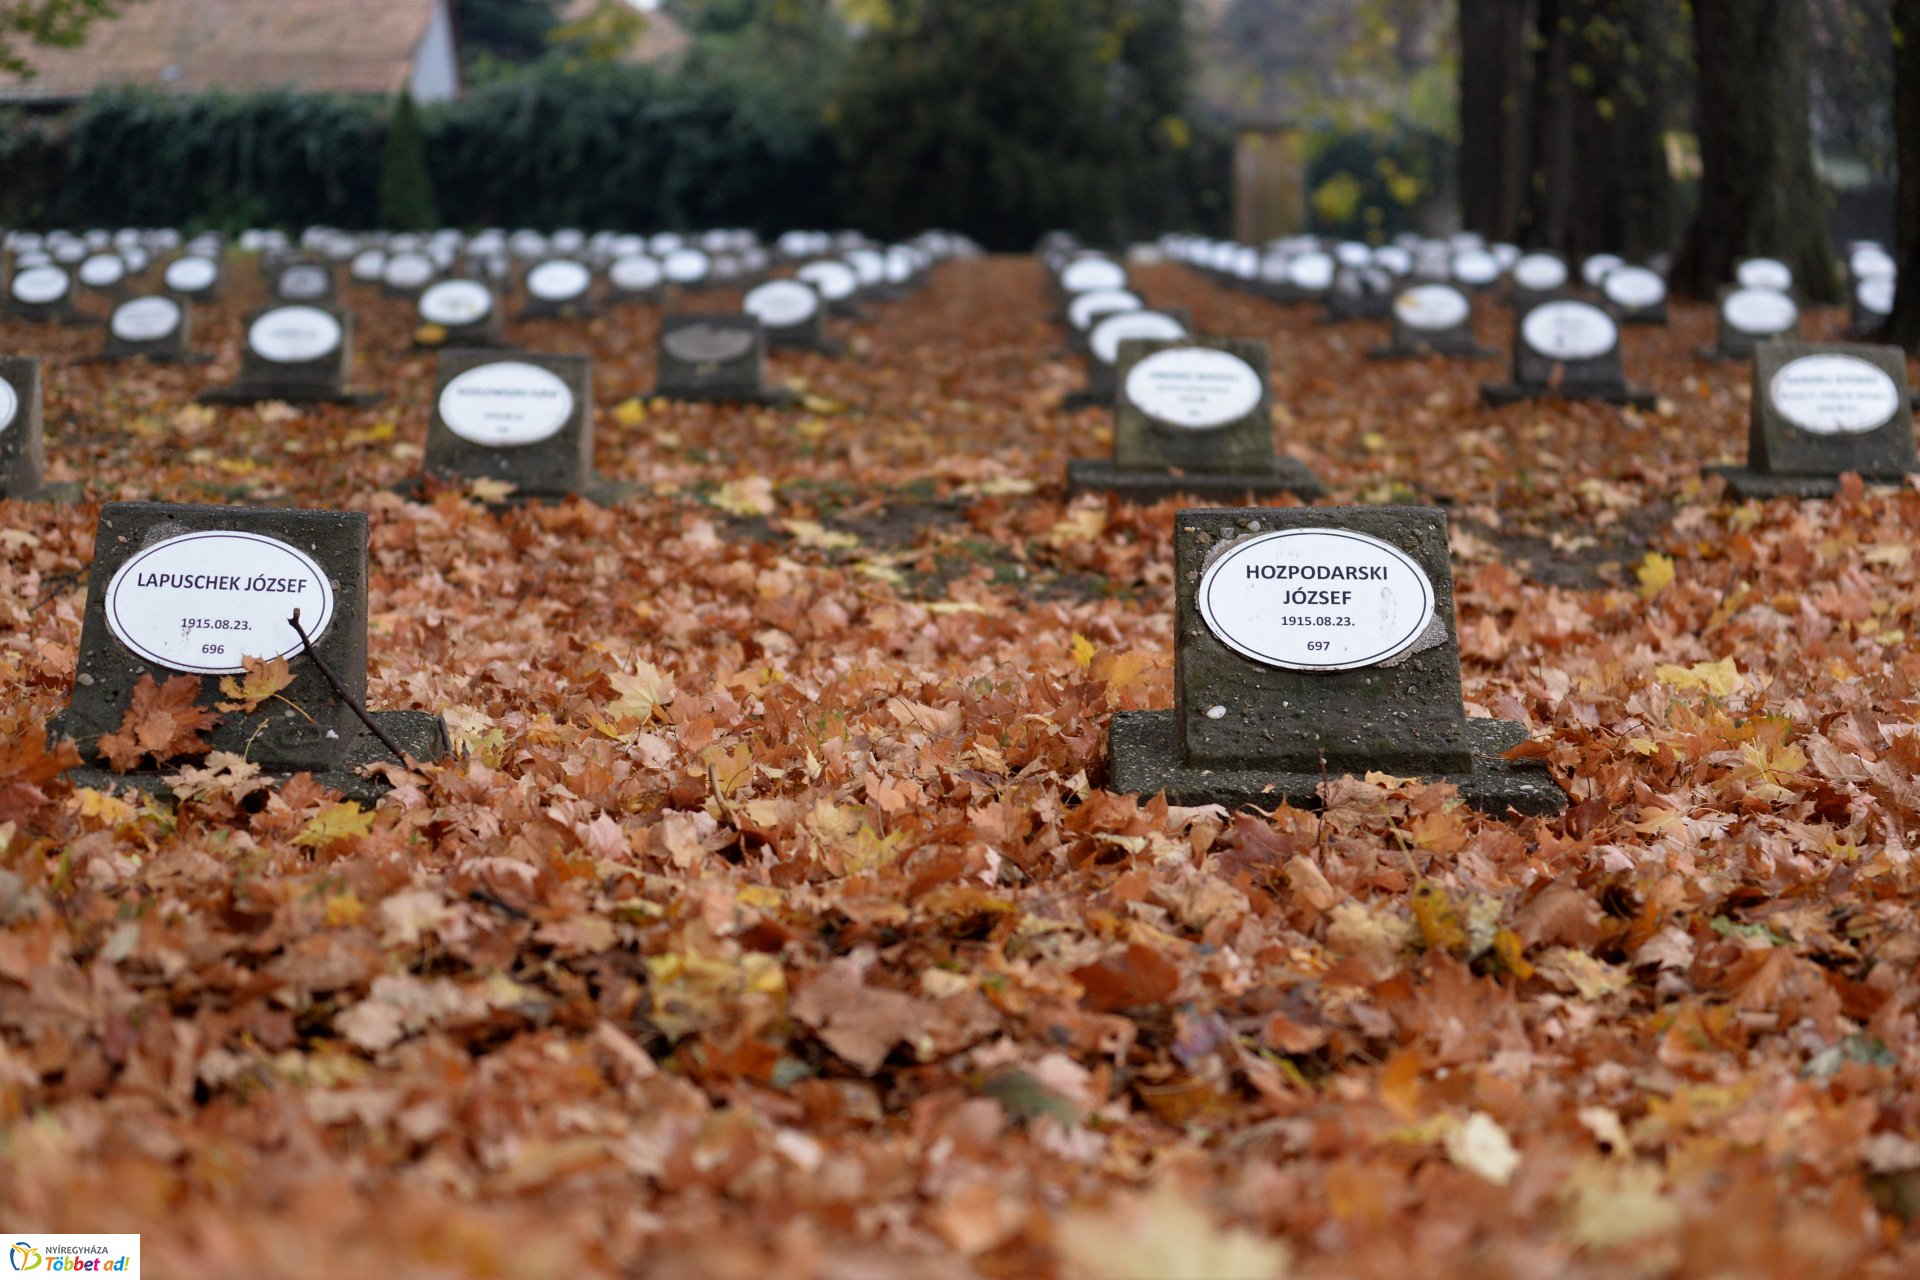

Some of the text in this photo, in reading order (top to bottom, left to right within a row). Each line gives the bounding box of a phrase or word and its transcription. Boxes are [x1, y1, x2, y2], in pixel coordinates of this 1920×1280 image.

[1246, 565, 1388, 580] HOZPODARSKI
[138, 573, 307, 593] LAPUSCHEK JÓZSEF
[1283, 587, 1351, 605] JÓZSEF
[181, 618, 252, 630] 1915.08.23.
[1281, 616, 1355, 626] 1915.08.23.
[202, 644, 225, 655] 696
[1307, 641, 1330, 651] 697
